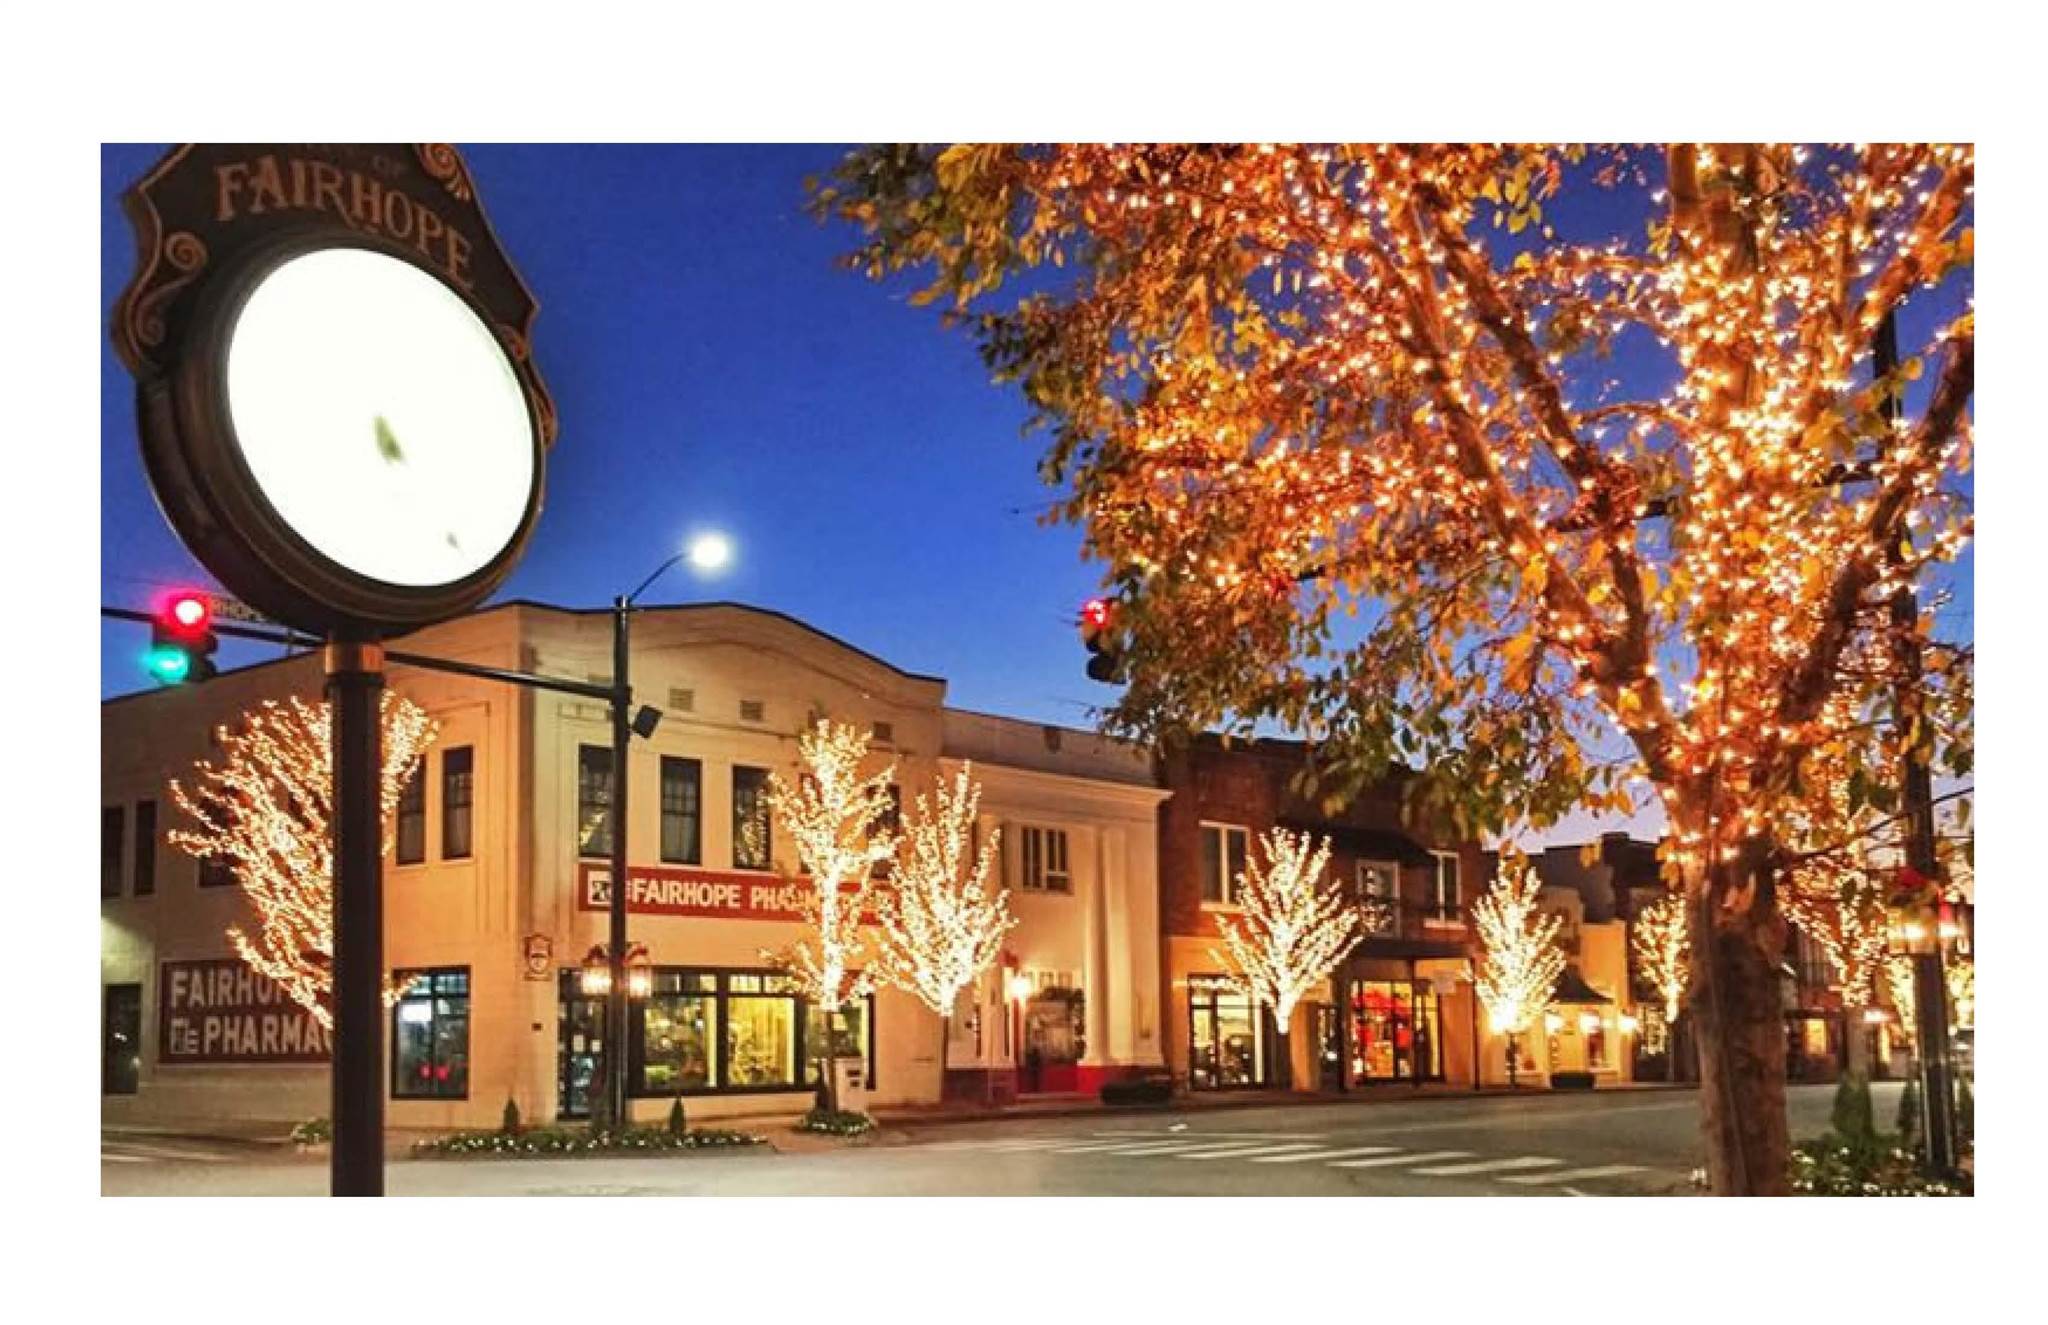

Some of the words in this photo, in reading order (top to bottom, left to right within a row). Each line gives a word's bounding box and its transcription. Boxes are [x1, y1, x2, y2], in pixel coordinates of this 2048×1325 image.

[212, 154, 474, 291] FAIRHOPE
[632, 877, 742, 909] FAIRHOPE
[170, 967, 284, 1008] FAIRHO
[203, 1013, 333, 1056] PHARMA
